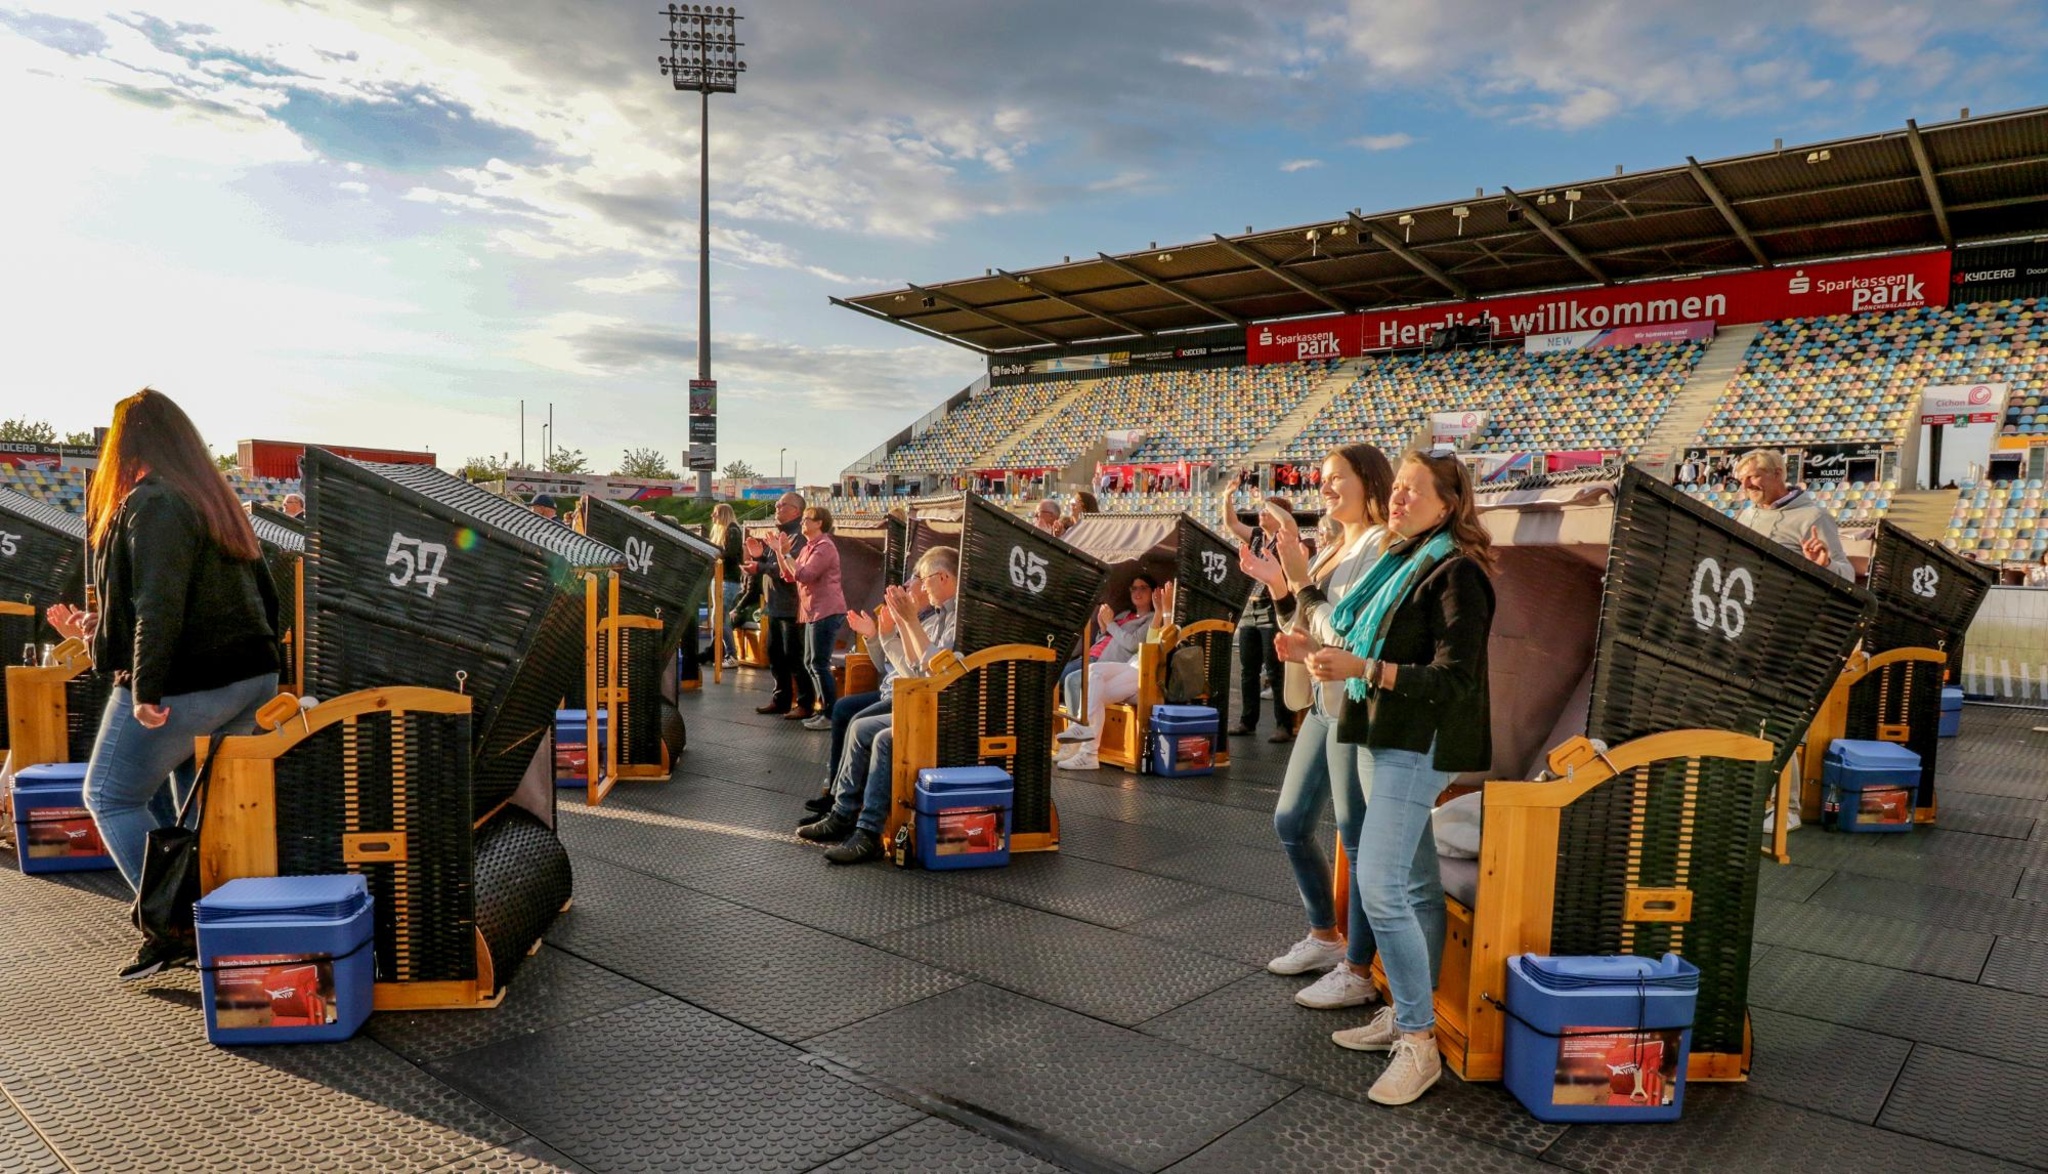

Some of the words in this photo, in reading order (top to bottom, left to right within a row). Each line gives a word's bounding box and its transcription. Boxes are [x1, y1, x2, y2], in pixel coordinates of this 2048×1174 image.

[1817, 274, 1906, 293] Sparkassen
[1965, 268, 2016, 282] KYOCERA
[1852, 274, 1925, 311] park
[1509, 294, 1726, 334] willkommen
[1276, 332, 1329, 346] Sparkassen
[1297, 332, 1340, 360] park
[1547, 336, 1573, 347] NEW
[0, 442, 37, 453] OCERA
[0, 530, 21, 557] 5
[625, 536, 654, 575] 64
[386, 532, 449, 597] 57
[1009, 545, 1049, 594] 65
[1201, 551, 1227, 584] 73
[1691, 558, 1754, 640] 66
